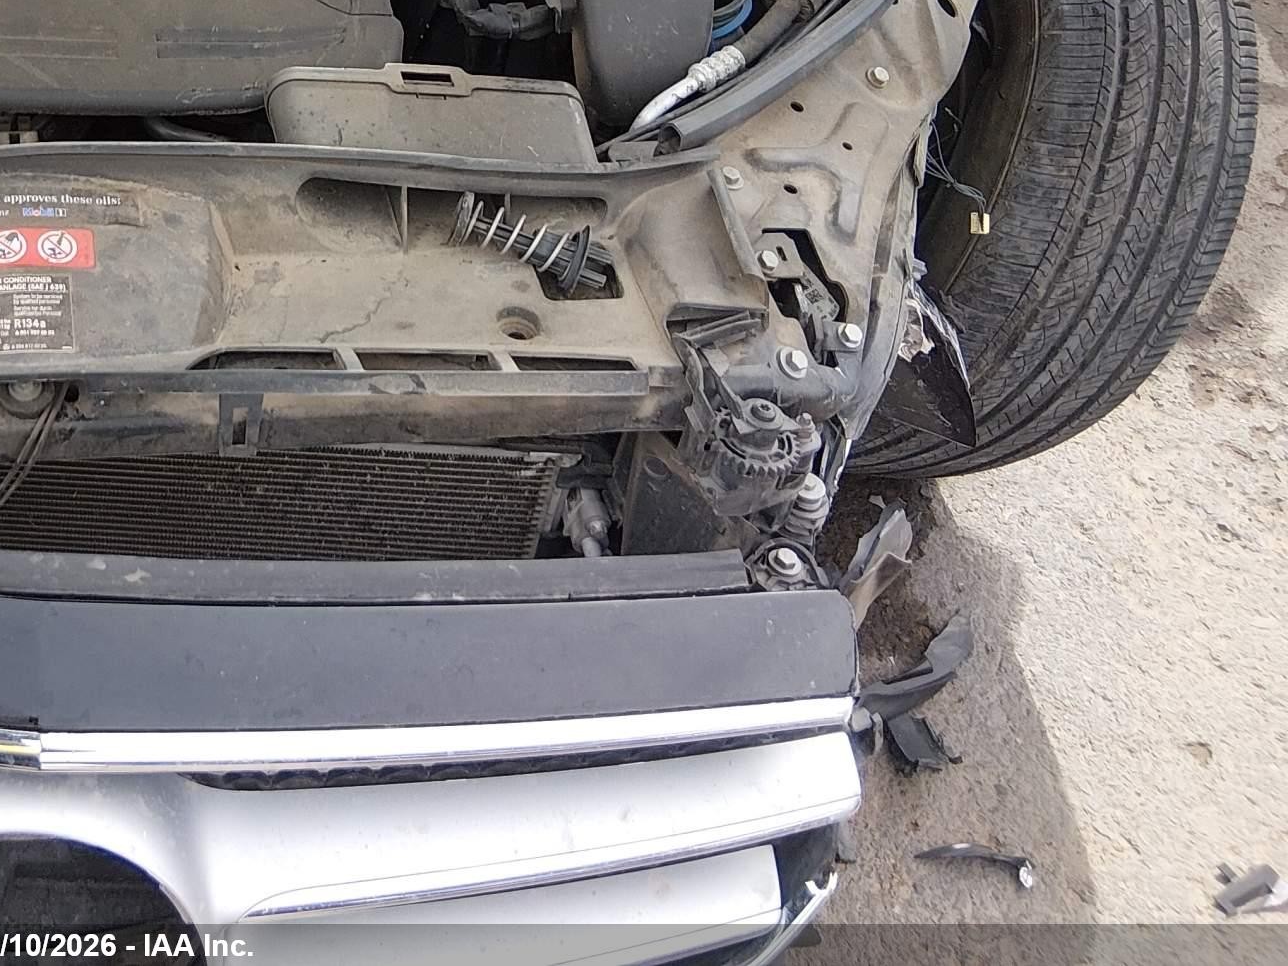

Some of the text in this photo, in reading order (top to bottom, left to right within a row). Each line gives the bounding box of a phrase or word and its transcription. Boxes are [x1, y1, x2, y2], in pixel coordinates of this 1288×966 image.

[4, 194, 58, 205] approves
[61, 194, 93, 205] these
[22, 205, 55, 218] Mobil
[3, 276, 52, 284] CONDITIONER
[14, 318, 47, 329] R134a
